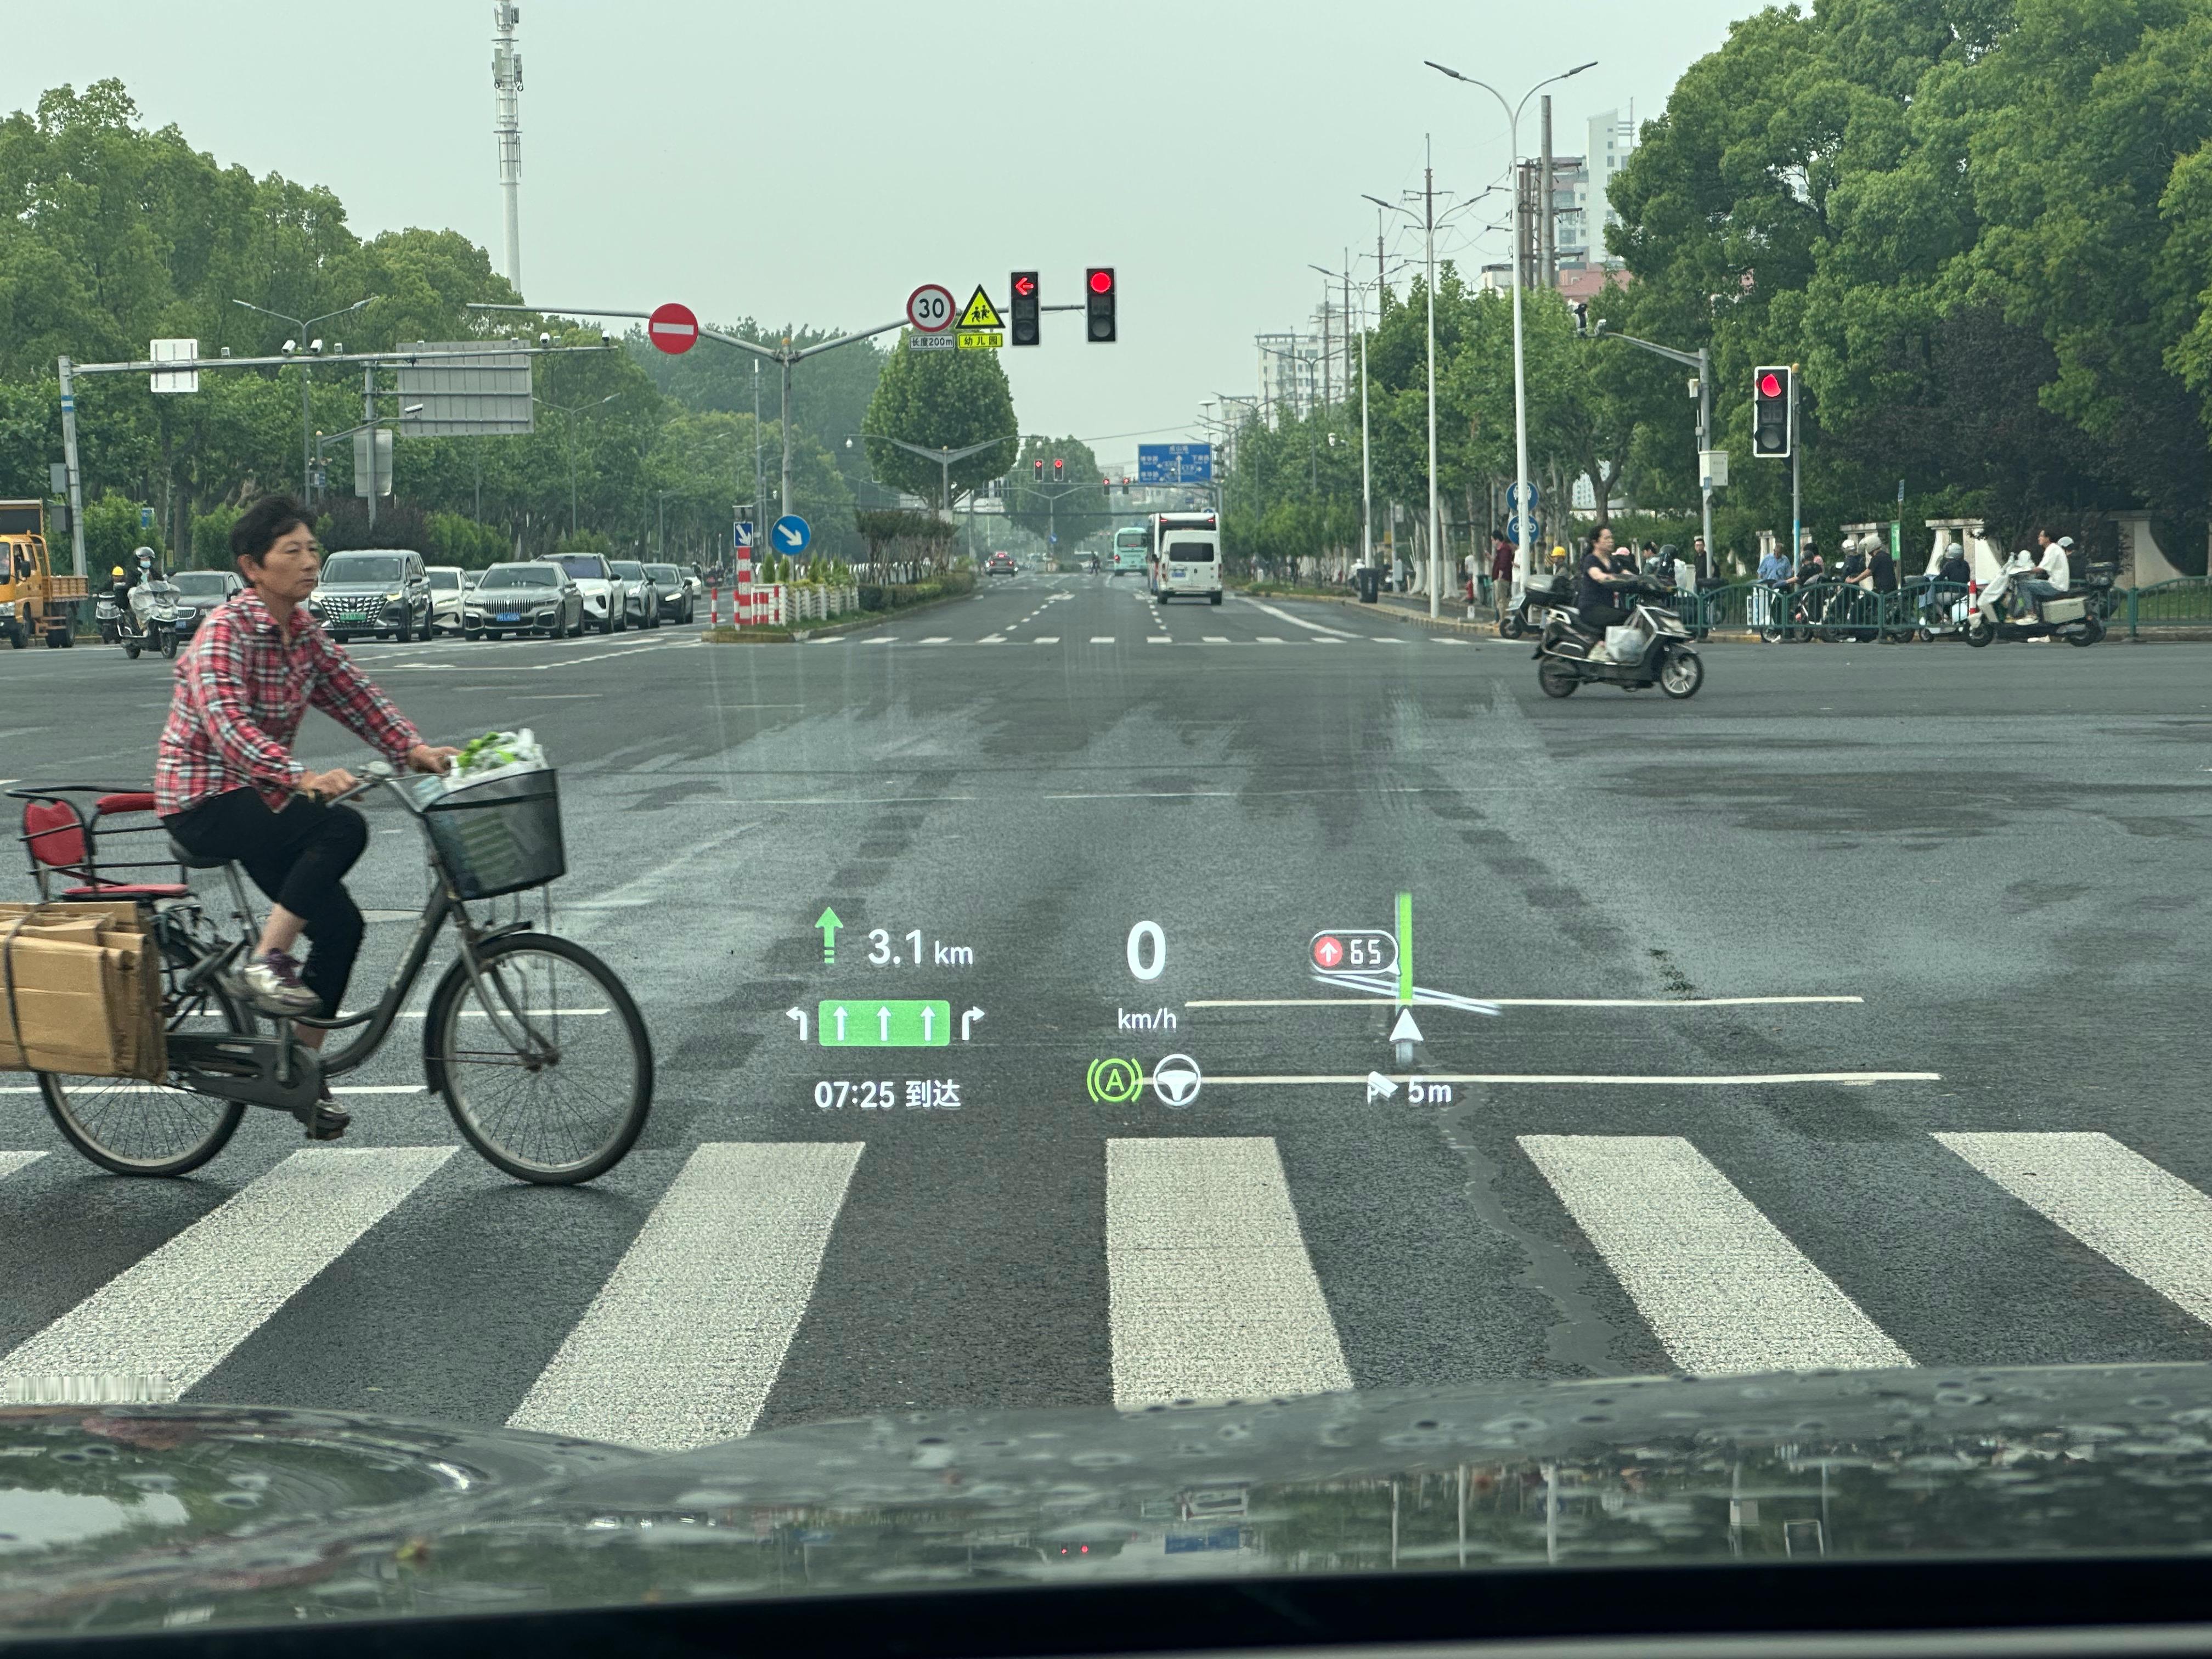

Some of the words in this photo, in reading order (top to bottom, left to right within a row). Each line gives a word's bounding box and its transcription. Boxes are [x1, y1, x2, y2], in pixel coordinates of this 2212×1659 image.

[918, 298, 944, 318] 30
[911, 337, 953, 347] 长度200m
[964, 335, 998, 346] 幼儿园
[867, 929, 922, 964] 3.1
[934, 940, 974, 964] km
[1127, 921, 1167, 980] 0
[1350, 939, 1381, 964] 65
[1118, 1008, 1178, 1030] km/h
[814, 1081, 895, 1109] 07:25
[905, 1079, 961, 1108] 到达
[1408, 1076, 1452, 1103] 5m
